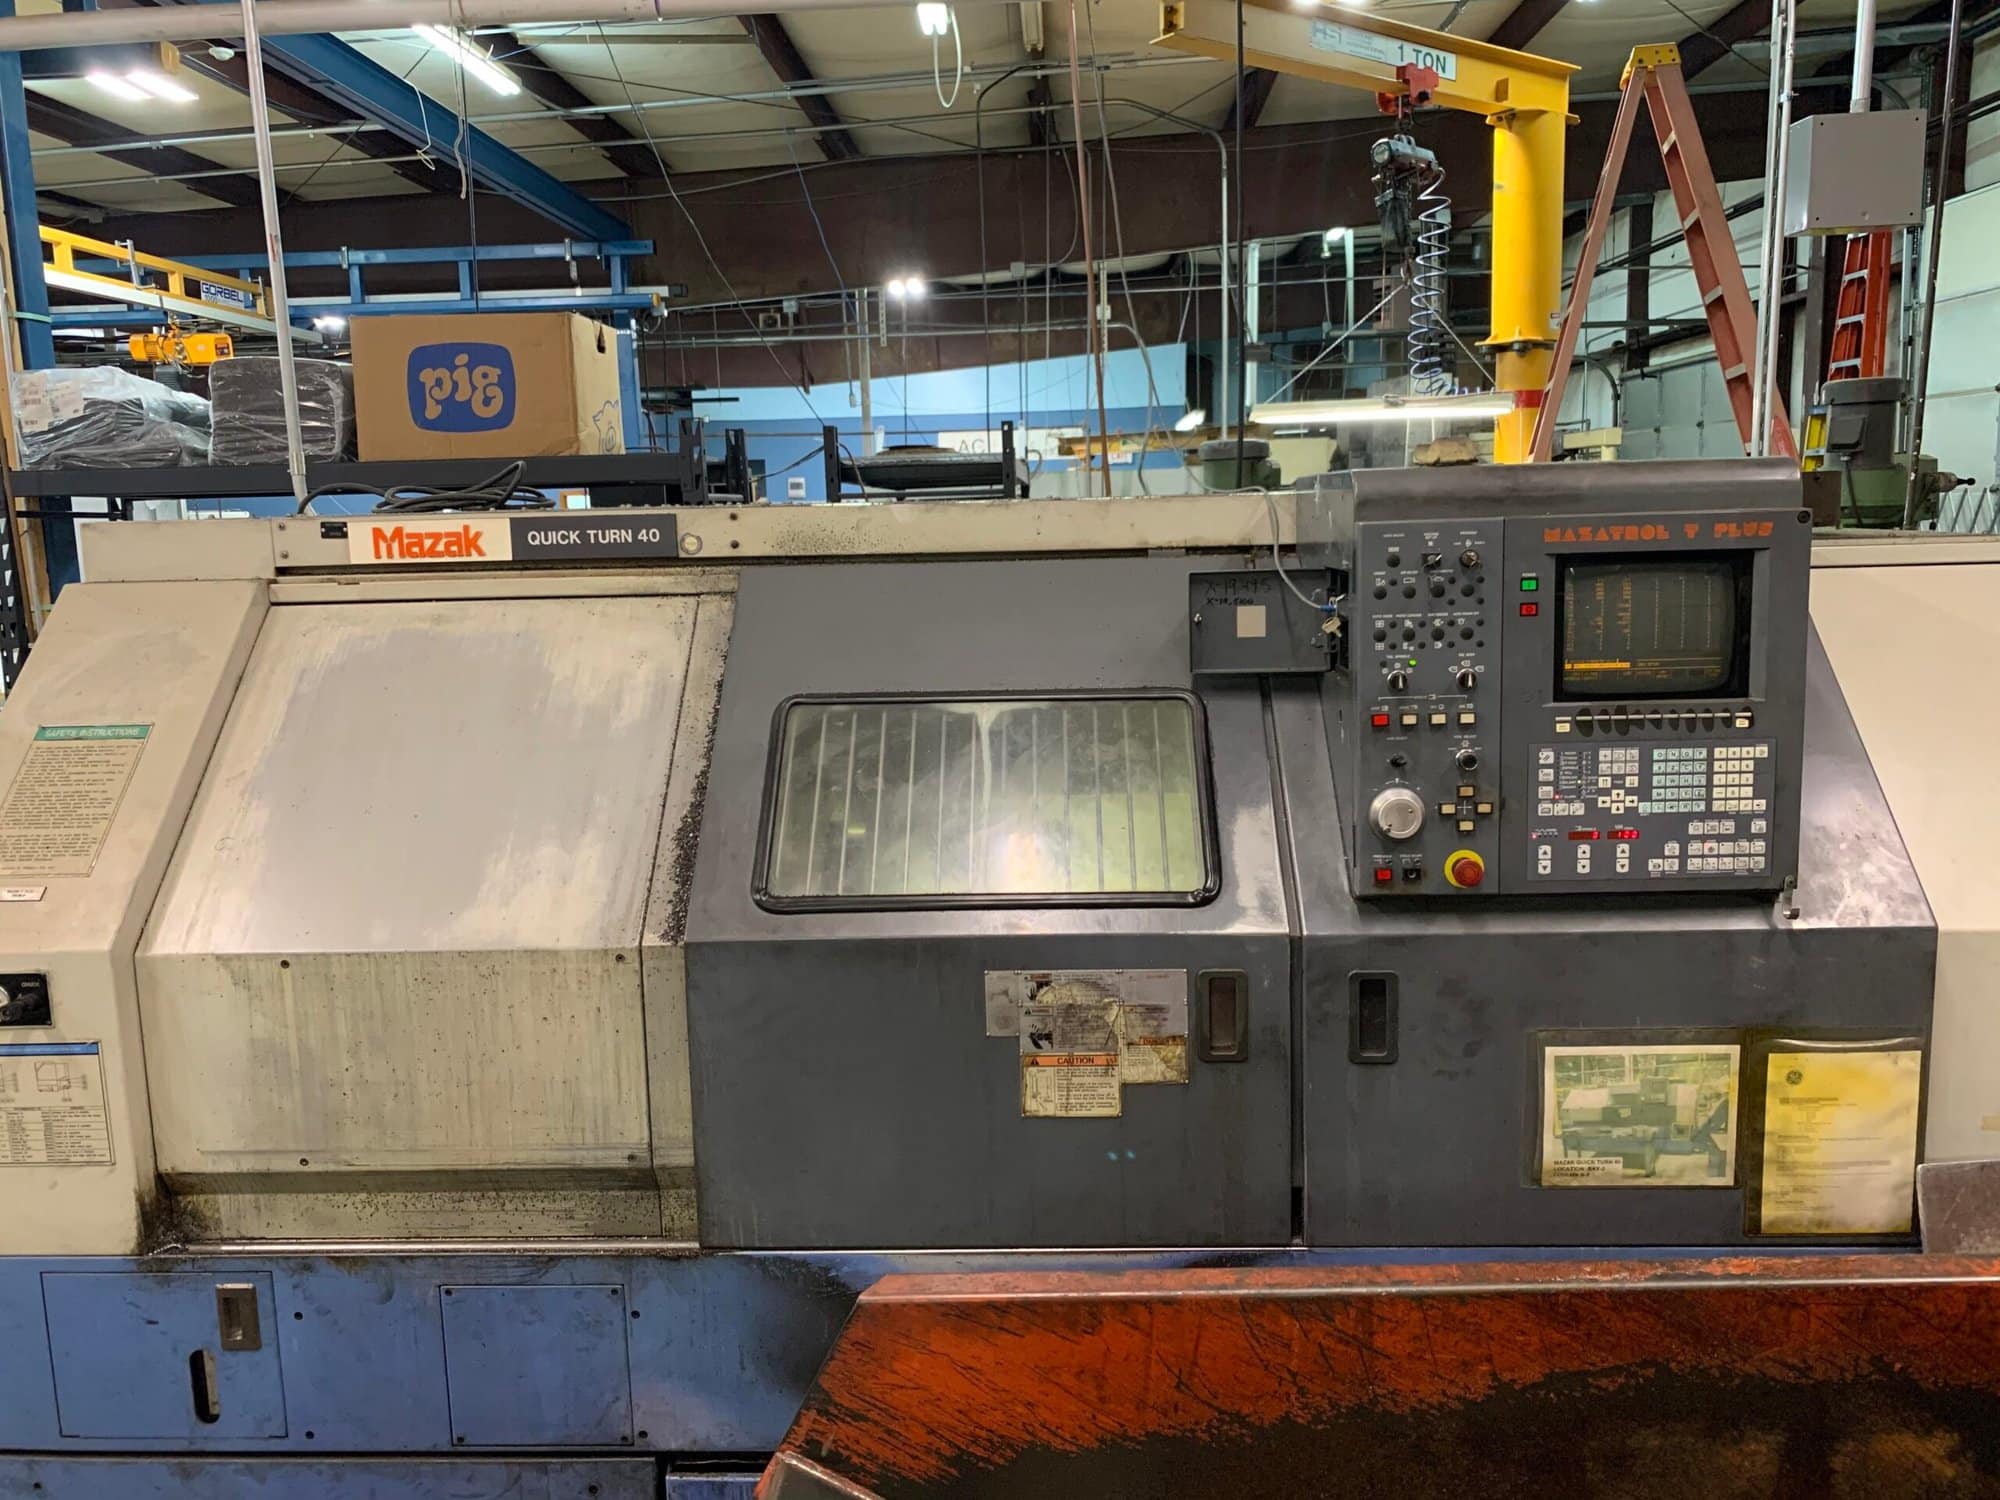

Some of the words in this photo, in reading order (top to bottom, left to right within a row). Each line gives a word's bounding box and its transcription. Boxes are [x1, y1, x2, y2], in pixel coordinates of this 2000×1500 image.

[1397, 43, 1405, 62] 1
[1412, 48, 1447, 73] TON
[201, 282, 243, 303] GORBEL
[418, 352, 504, 420] pig
[372, 525, 486, 559] Mazak
[527, 529, 582, 546] QUICK
[586, 529, 633, 545] TURN
[637, 528, 660, 544] 40
[1543, 523, 1671, 543] MAZATROL
[1713, 521, 1774, 539] PLUS
[45, 729, 78, 738] SAFETY
[79, 728, 139, 737] INSTRUCTIONS
[1056, 1057, 1094, 1065] CAUTION
